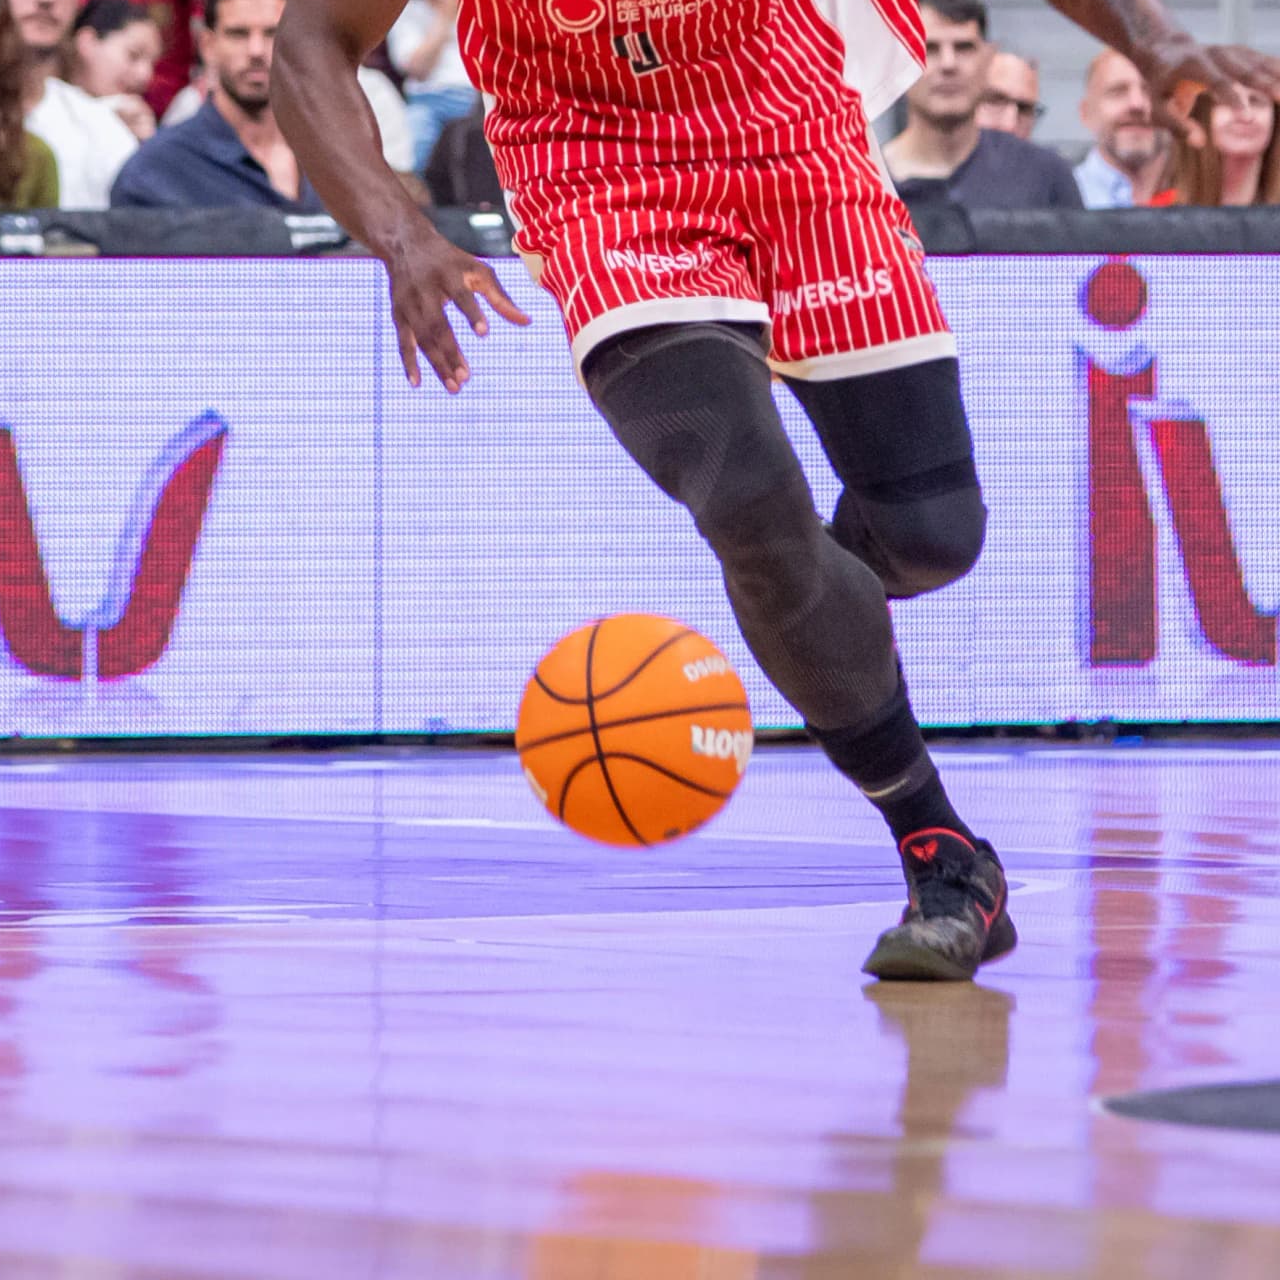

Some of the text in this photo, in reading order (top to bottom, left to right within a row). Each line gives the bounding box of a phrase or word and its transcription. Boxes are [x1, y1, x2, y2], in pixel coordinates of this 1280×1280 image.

[617, 0, 710, 23] DE MURC
[773, 267, 893, 317] INVERSUS
